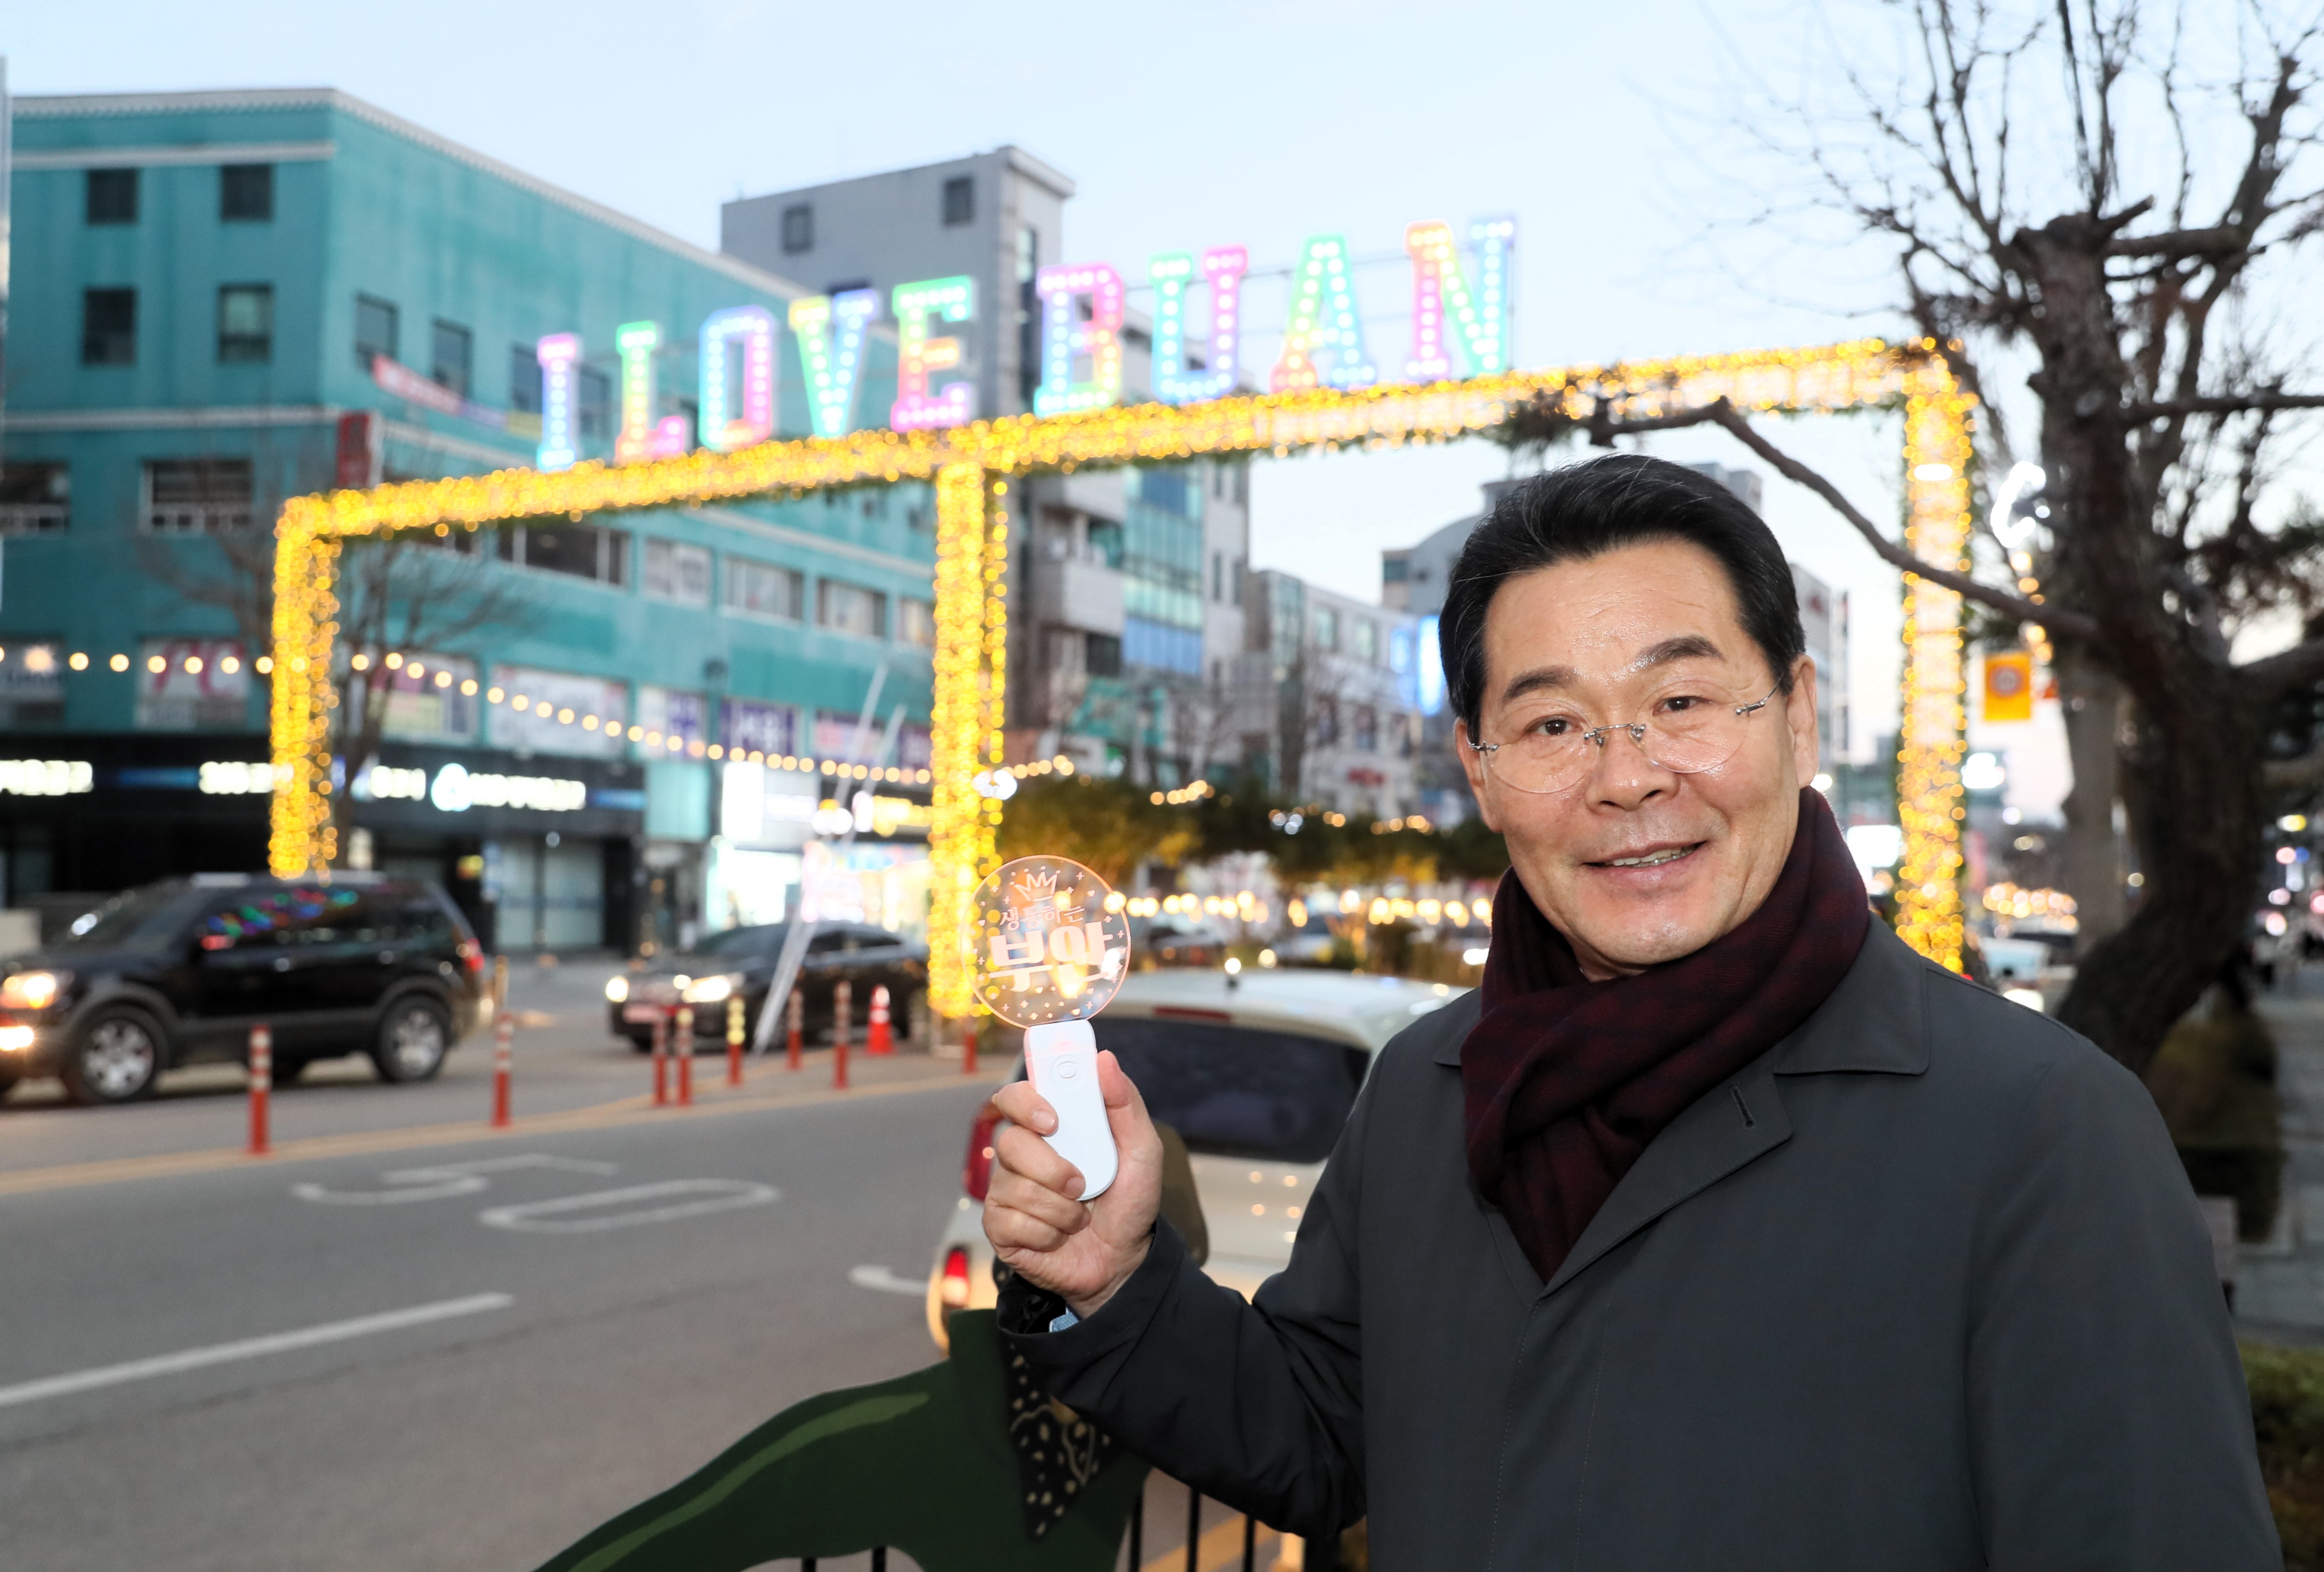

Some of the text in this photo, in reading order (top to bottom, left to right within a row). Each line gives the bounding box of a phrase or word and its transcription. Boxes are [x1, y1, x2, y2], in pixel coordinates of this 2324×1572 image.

[537, 333, 577, 471] I
[615, 275, 972, 464] LOVE
[1033, 217, 1518, 418] BUAN
[1000, 904, 1085, 930] 생동하는
[989, 922, 1113, 992] 부안
